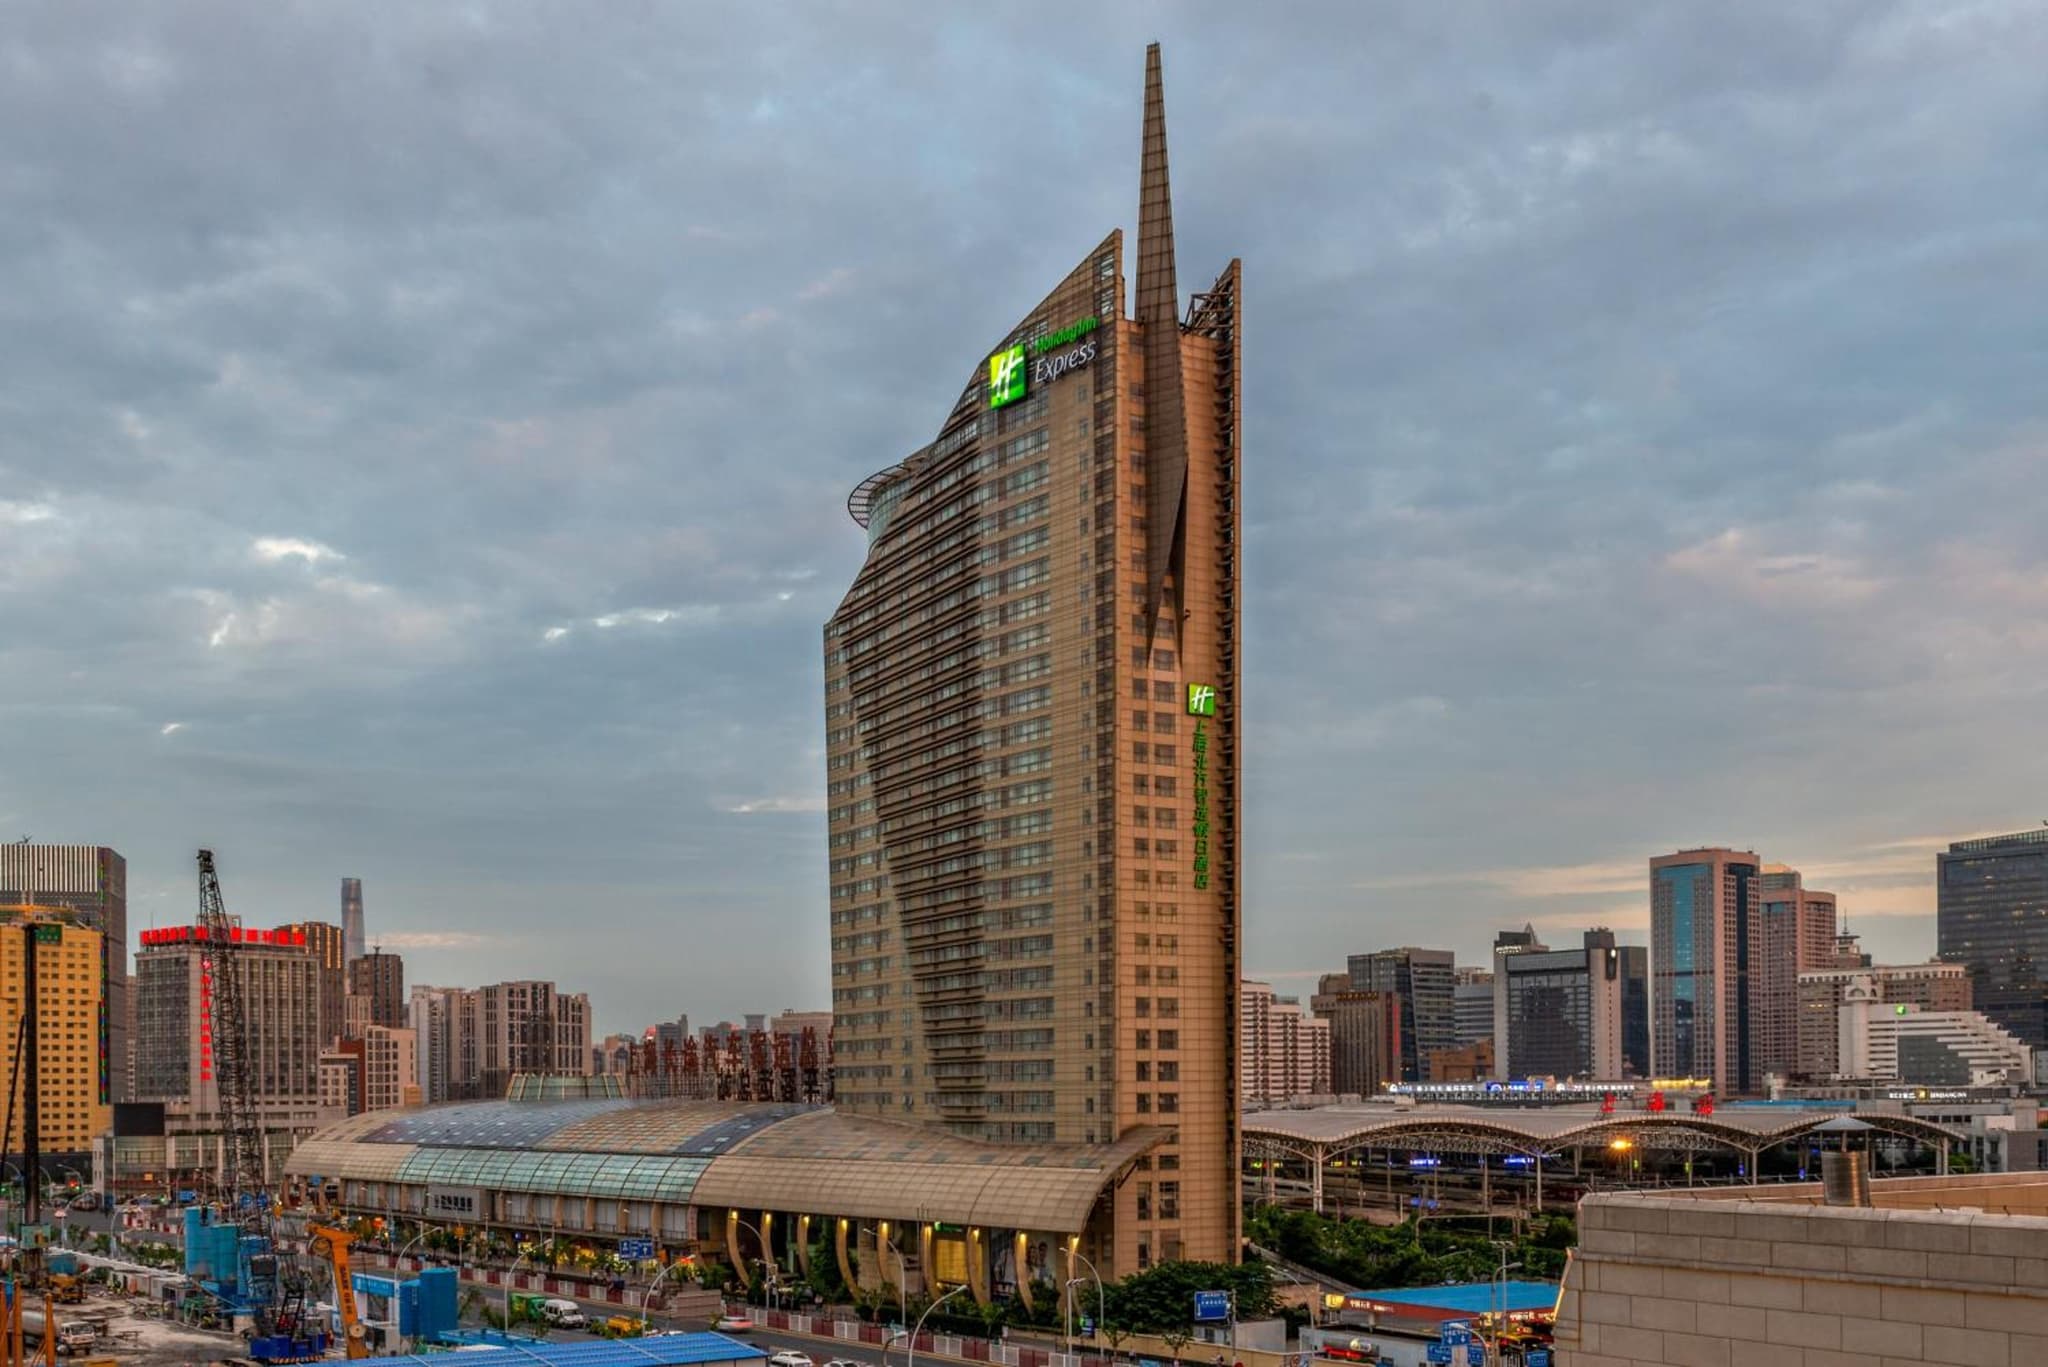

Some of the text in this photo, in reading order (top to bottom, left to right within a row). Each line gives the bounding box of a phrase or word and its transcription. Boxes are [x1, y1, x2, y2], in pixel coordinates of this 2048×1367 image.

[1036, 316, 1098, 352] Holiday Inn
[1035, 341, 1097, 383] Express
